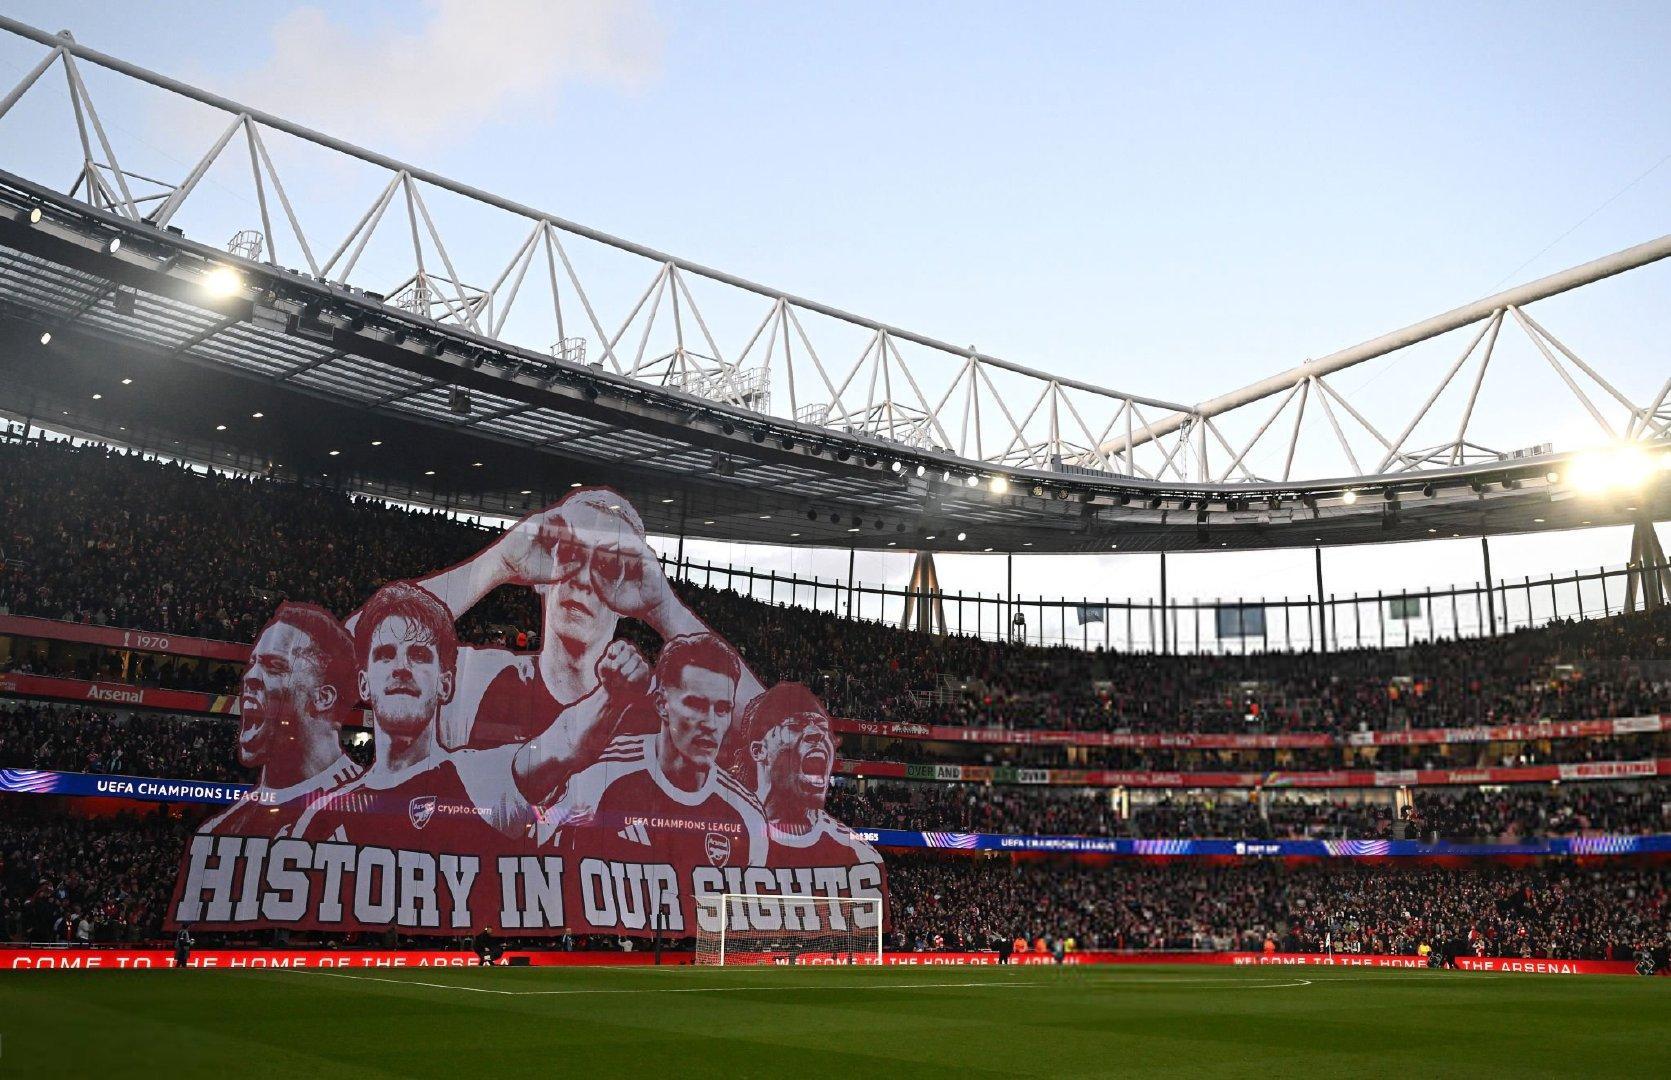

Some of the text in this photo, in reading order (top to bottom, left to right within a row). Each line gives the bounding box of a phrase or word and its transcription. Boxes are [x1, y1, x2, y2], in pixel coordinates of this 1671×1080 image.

[137, 635, 169, 650] 1970
[87, 685, 144, 703] Arsenal
[858, 723, 878, 733] 1992
[97, 780, 277, 803] UEFA CHAMPIONS LEAGUE
[437, 803, 492, 815] crypto.com
[624, 816, 741, 833] UEFA CHAMPIONS LEAGUE
[176, 835, 885, 931] HISTORY IN OUR SIGHTS
[12, 957, 102, 969] COME
[116, 957, 152, 969] TO
[230, 957, 307, 968] HOME
[319, 957, 351, 968] OF
[362, 957, 408, 967] THE
[1341, 957, 1372, 966] THE
[1380, 959, 1427, 968] HOME
[1462, 960, 1577, 974] THE ARSENAL
